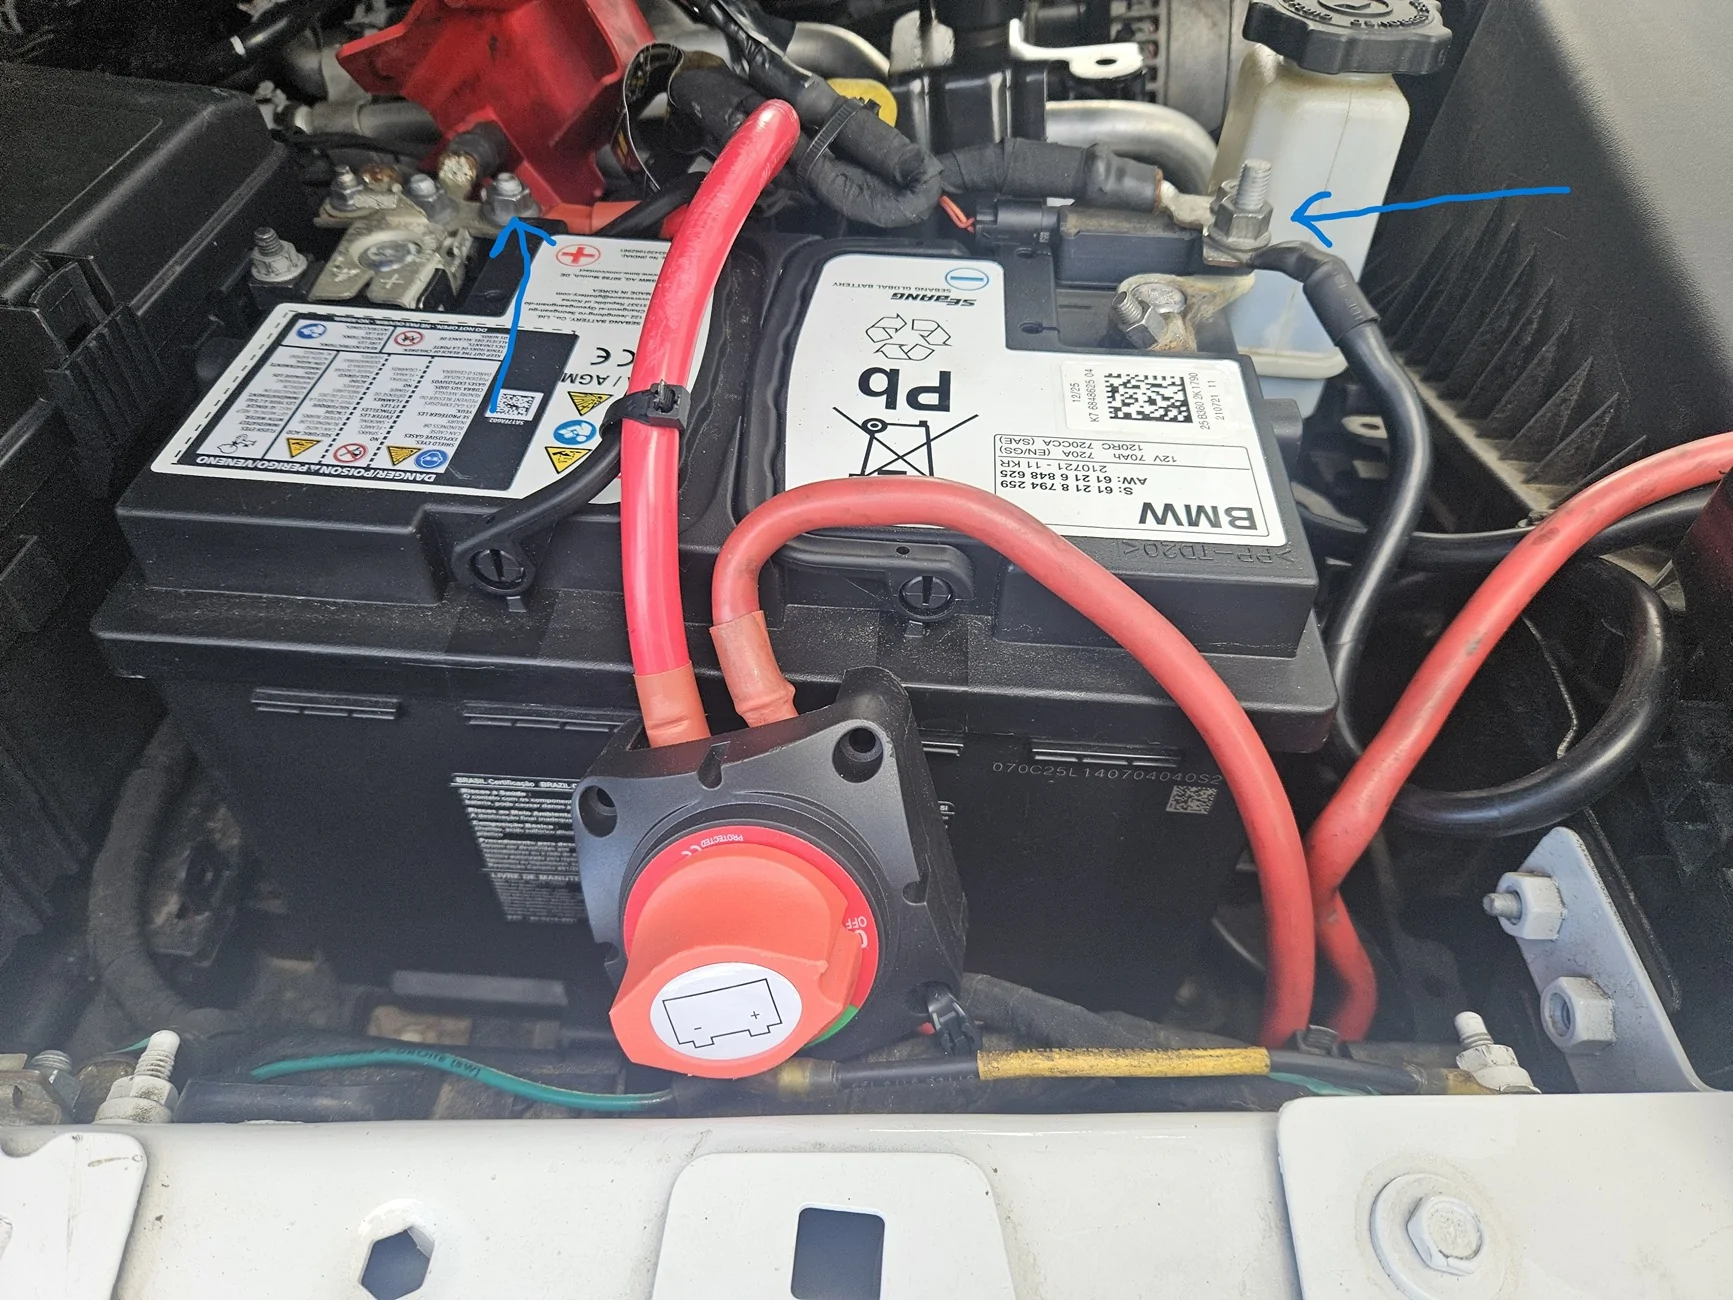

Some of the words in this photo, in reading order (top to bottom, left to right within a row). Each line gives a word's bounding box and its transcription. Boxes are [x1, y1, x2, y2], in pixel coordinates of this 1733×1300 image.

[561, 372, 610, 386] AGM
[858, 367, 951, 412] Pb
[1069, 382, 1082, 403] 12/25
[1211, 394, 1225, 420] 210721
[1088, 412, 1100, 423] K7
[424, 434, 458, 442] EXPLOSIVE
[998, 436, 1035, 446] (SAE)
[1043, 439, 1094, 449] 720CCA
[1101, 442, 1143, 451] 120RC
[999, 446, 1051, 456] (EN/GS)
[1061, 450, 1094, 459] 720A
[1113, 453, 1146, 462] 70Ah
[1153, 455, 1177, 463] 12V
[196, 456, 309, 471] PERIGO/VENENO
[999, 459, 1021, 468] KR
[1027, 460, 1042, 469] 11
[1057, 462, 1108, 474] 210721
[319, 465, 437, 482] DANGER/POISON
[1000, 470, 1026, 479] 625
[1031, 471, 1056, 481] 848
[1060, 473, 1069, 482] 6
[1074, 474, 1090, 483] 21
[1000, 480, 1026, 489] 259
[1096, 475, 1112, 484] 61
[1117, 476, 1147, 486] AW:
[1031, 481, 1056, 491] 794
[1061, 483, 1070, 492] 8
[1075, 484, 1091, 493] 21
[1097, 485, 1113, 494] 61
[1118, 486, 1134, 496] S:
[1138, 502, 1258, 531] BMW
[455, 776, 487, 784] BRASIL
[700, 834, 744, 847] PROTECTED
[845, 916, 867, 929] OFF
